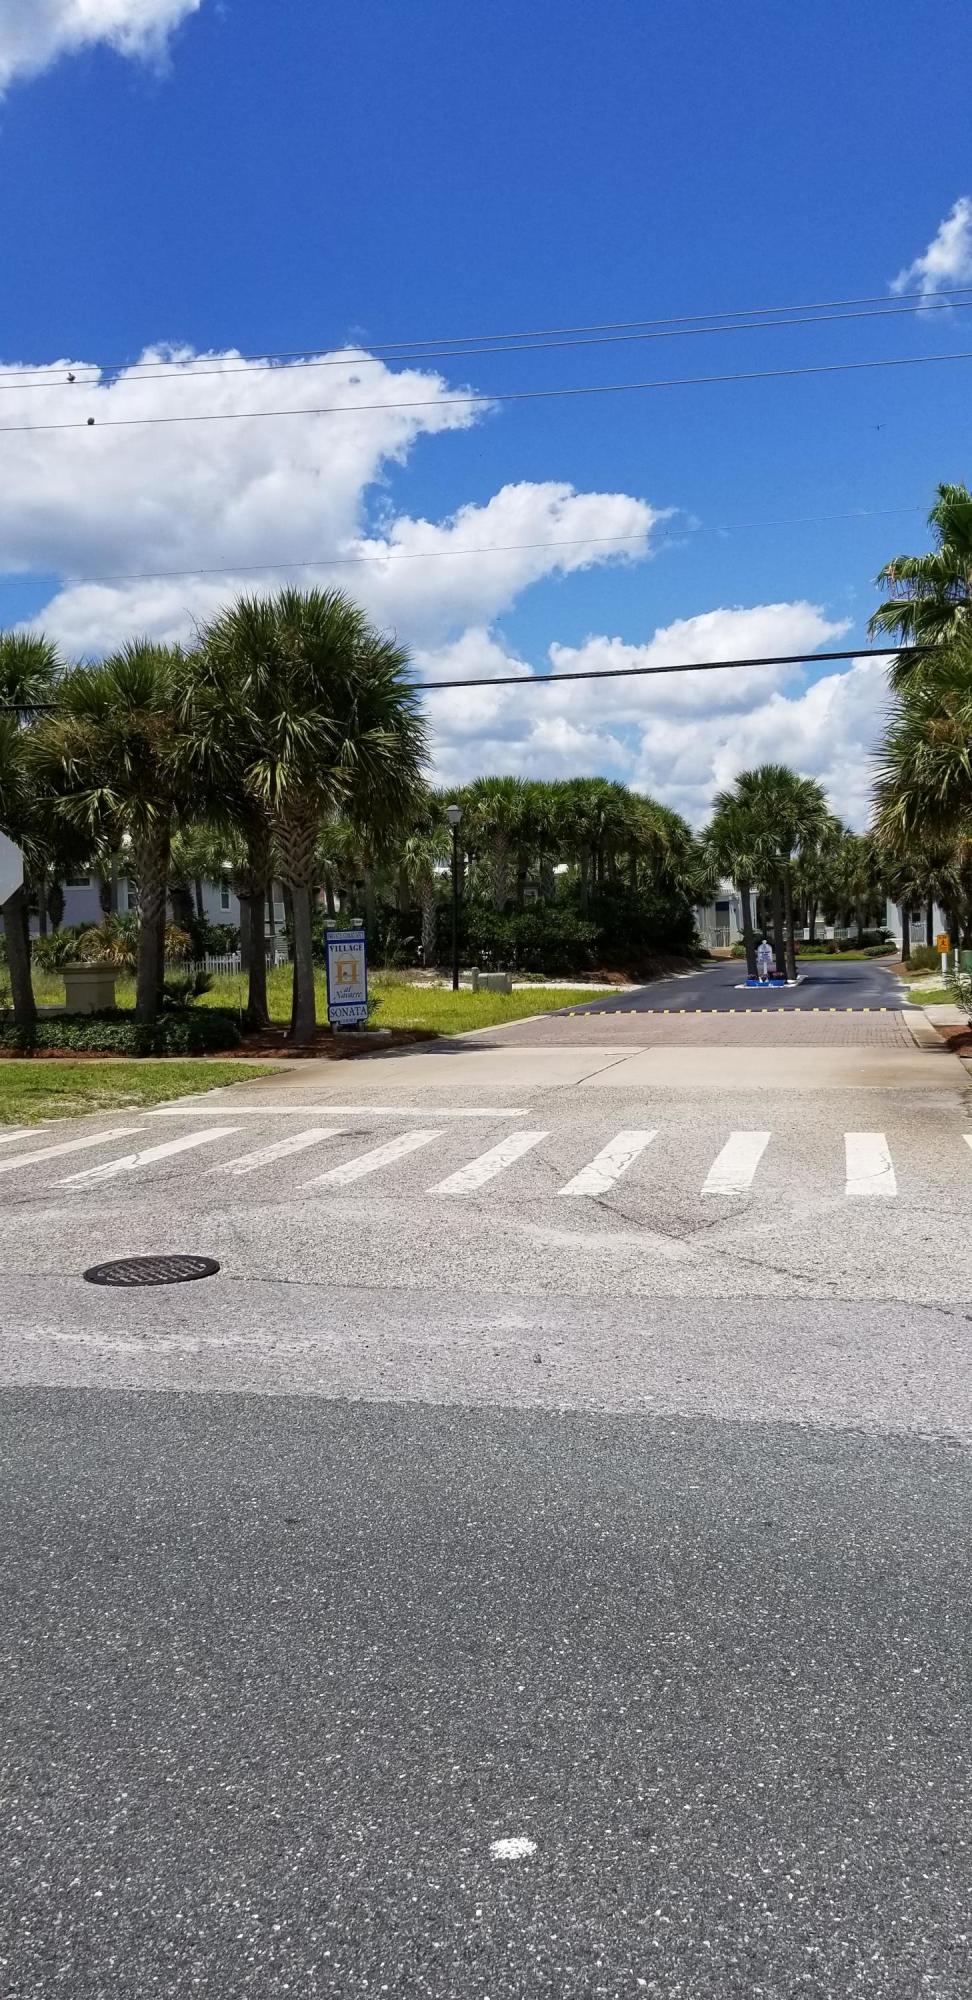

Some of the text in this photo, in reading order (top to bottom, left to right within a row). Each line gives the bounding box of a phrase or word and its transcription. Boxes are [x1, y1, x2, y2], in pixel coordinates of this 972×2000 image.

[329, 944, 364, 952] VILLAGE
[336, 991, 362, 999] Navarre
[330, 1006, 367, 1018] SONATA
